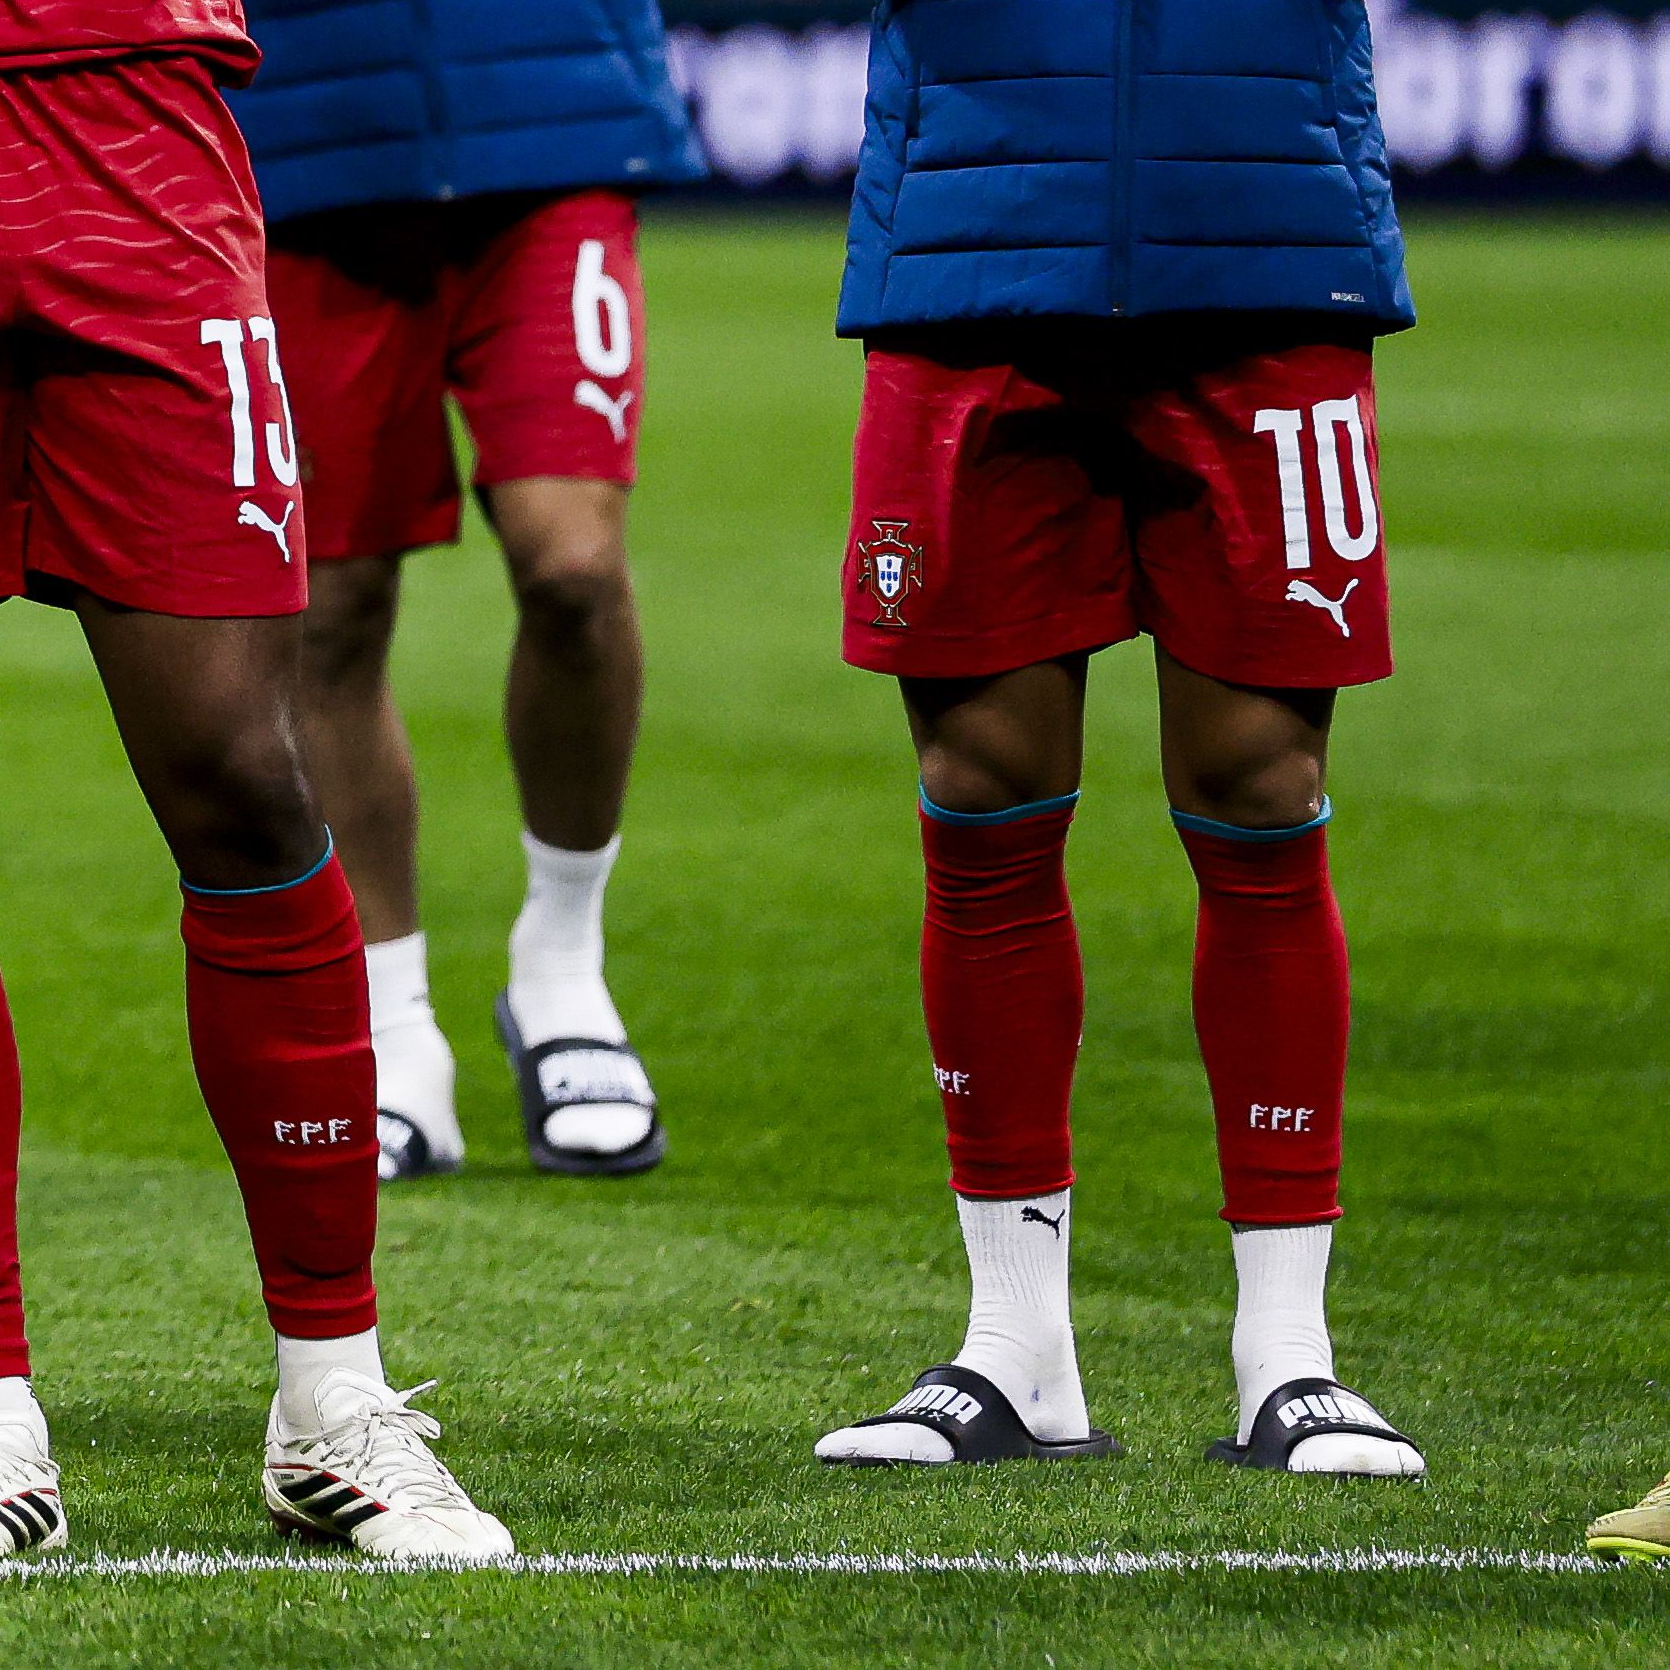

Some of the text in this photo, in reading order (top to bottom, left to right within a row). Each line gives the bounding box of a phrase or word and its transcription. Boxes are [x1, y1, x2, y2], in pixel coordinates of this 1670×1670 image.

[572, 238, 633, 378] 6
[201, 316, 297, 487] 13
[1253, 394, 1378, 569] 10
